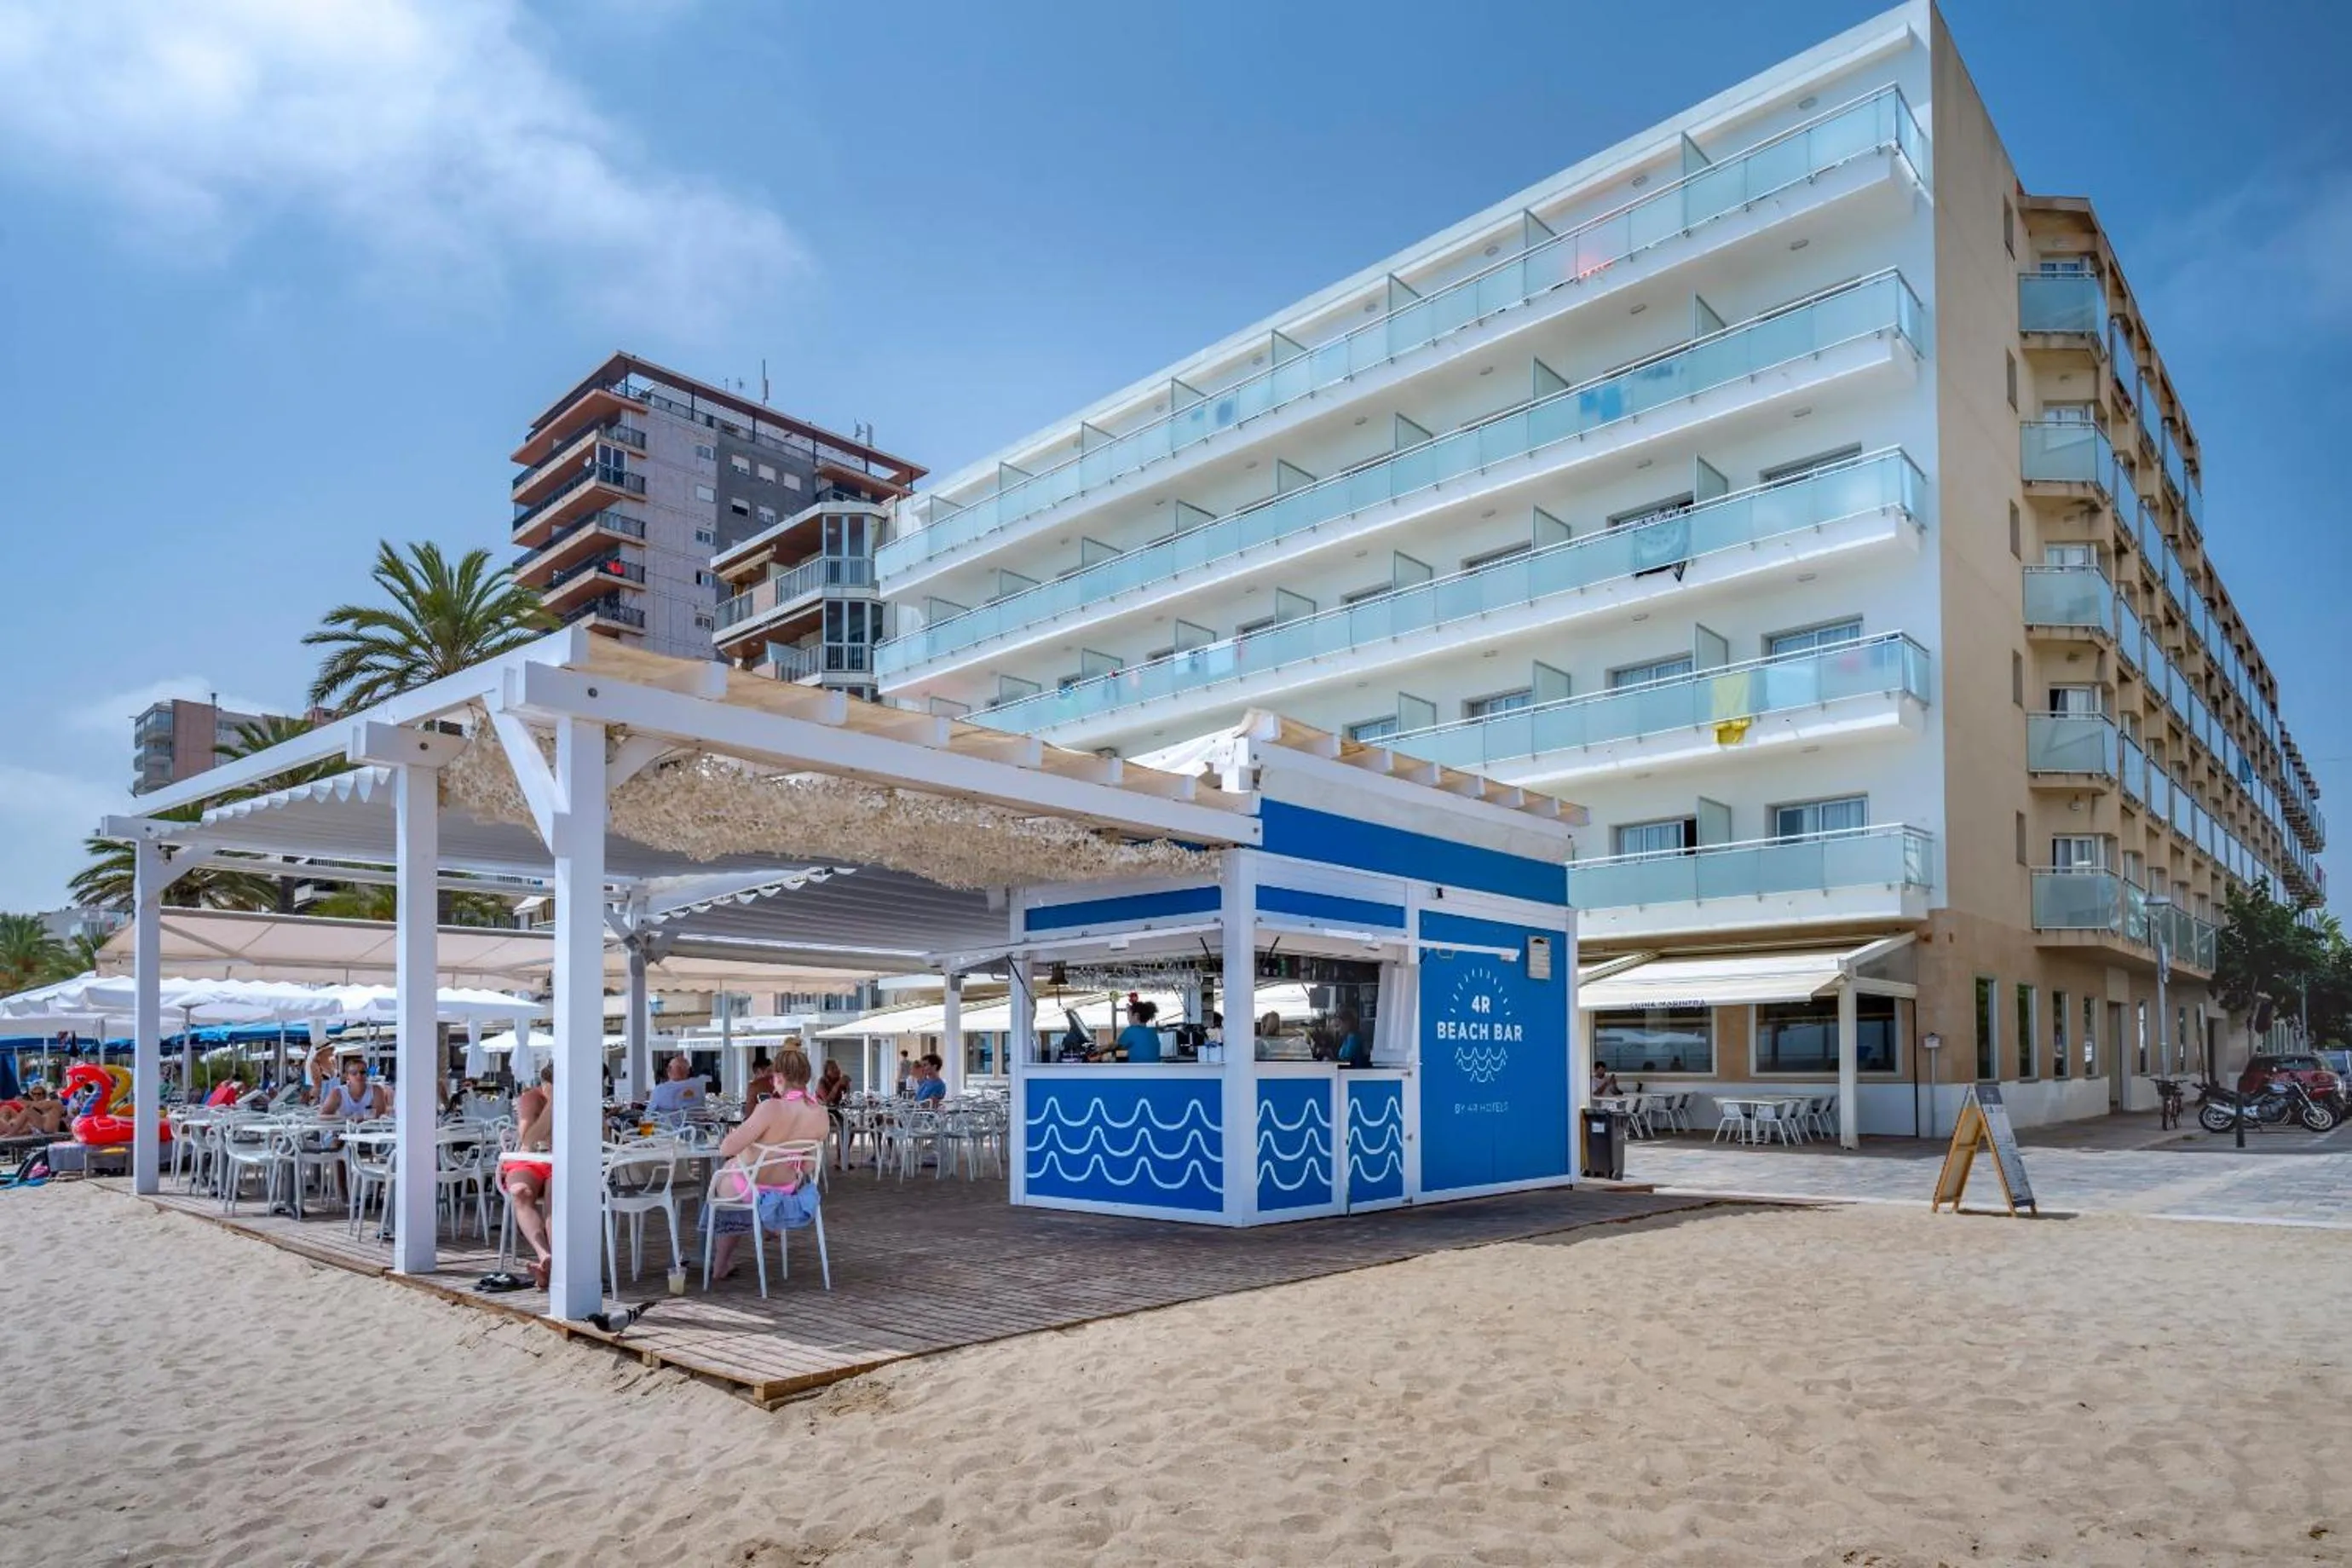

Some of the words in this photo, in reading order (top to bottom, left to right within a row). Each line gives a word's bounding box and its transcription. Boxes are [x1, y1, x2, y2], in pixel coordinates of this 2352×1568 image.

[1471, 994, 1490, 1013] 4R
[1437, 1022, 1489, 1041] BEACH
[1493, 1023, 1523, 1041] BAR
